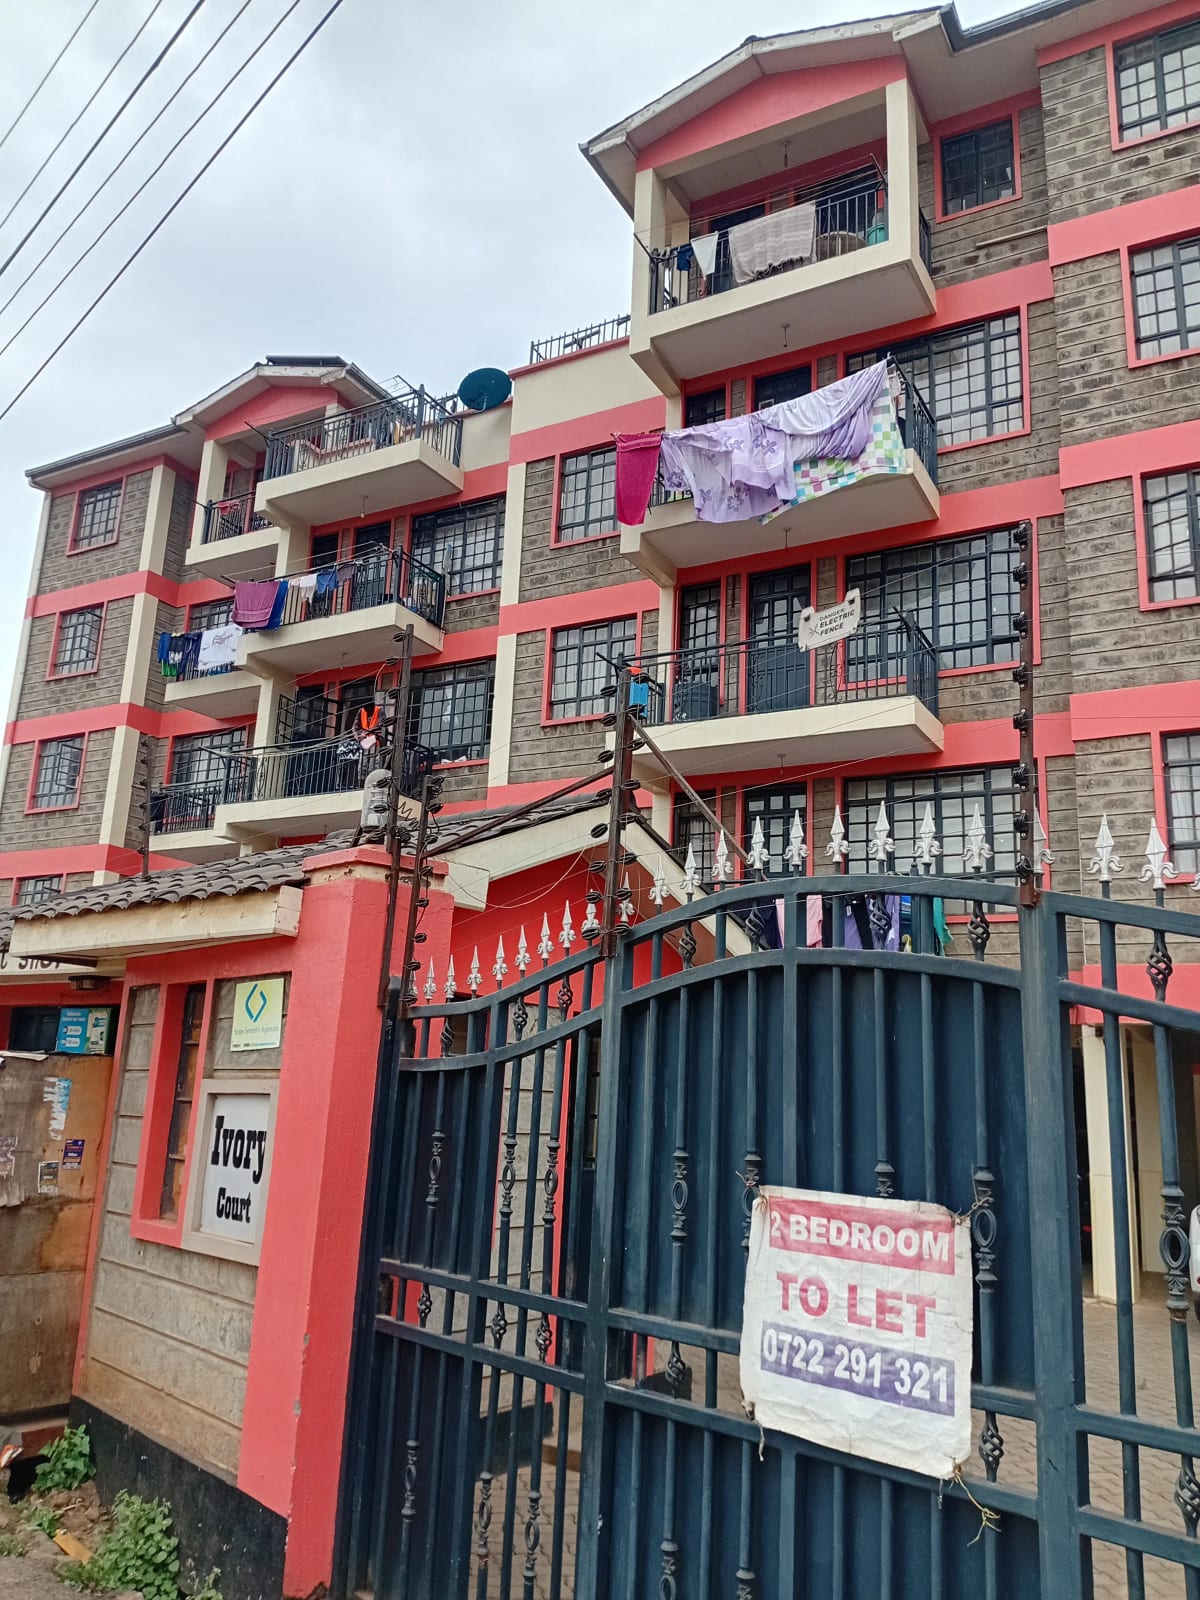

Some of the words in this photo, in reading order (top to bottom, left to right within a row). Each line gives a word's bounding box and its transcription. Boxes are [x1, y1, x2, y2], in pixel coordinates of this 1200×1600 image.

[819, 608, 845, 621] DANGER
[820, 610, 855, 628] ELECTRIC
[820, 623, 844, 636] FENCE
[211, 1115, 267, 1184] Ivory
[216, 1187, 251, 1223] Court
[770, 1211, 782, 1237] 2
[789, 1214, 949, 1262] BEDROOM
[776, 1270, 829, 1317] TO
[847, 1283, 937, 1338] LET
[762, 1328, 824, 1375] 0722
[833, 1344, 882, 1388] 291
[894, 1358, 948, 1402] 321
